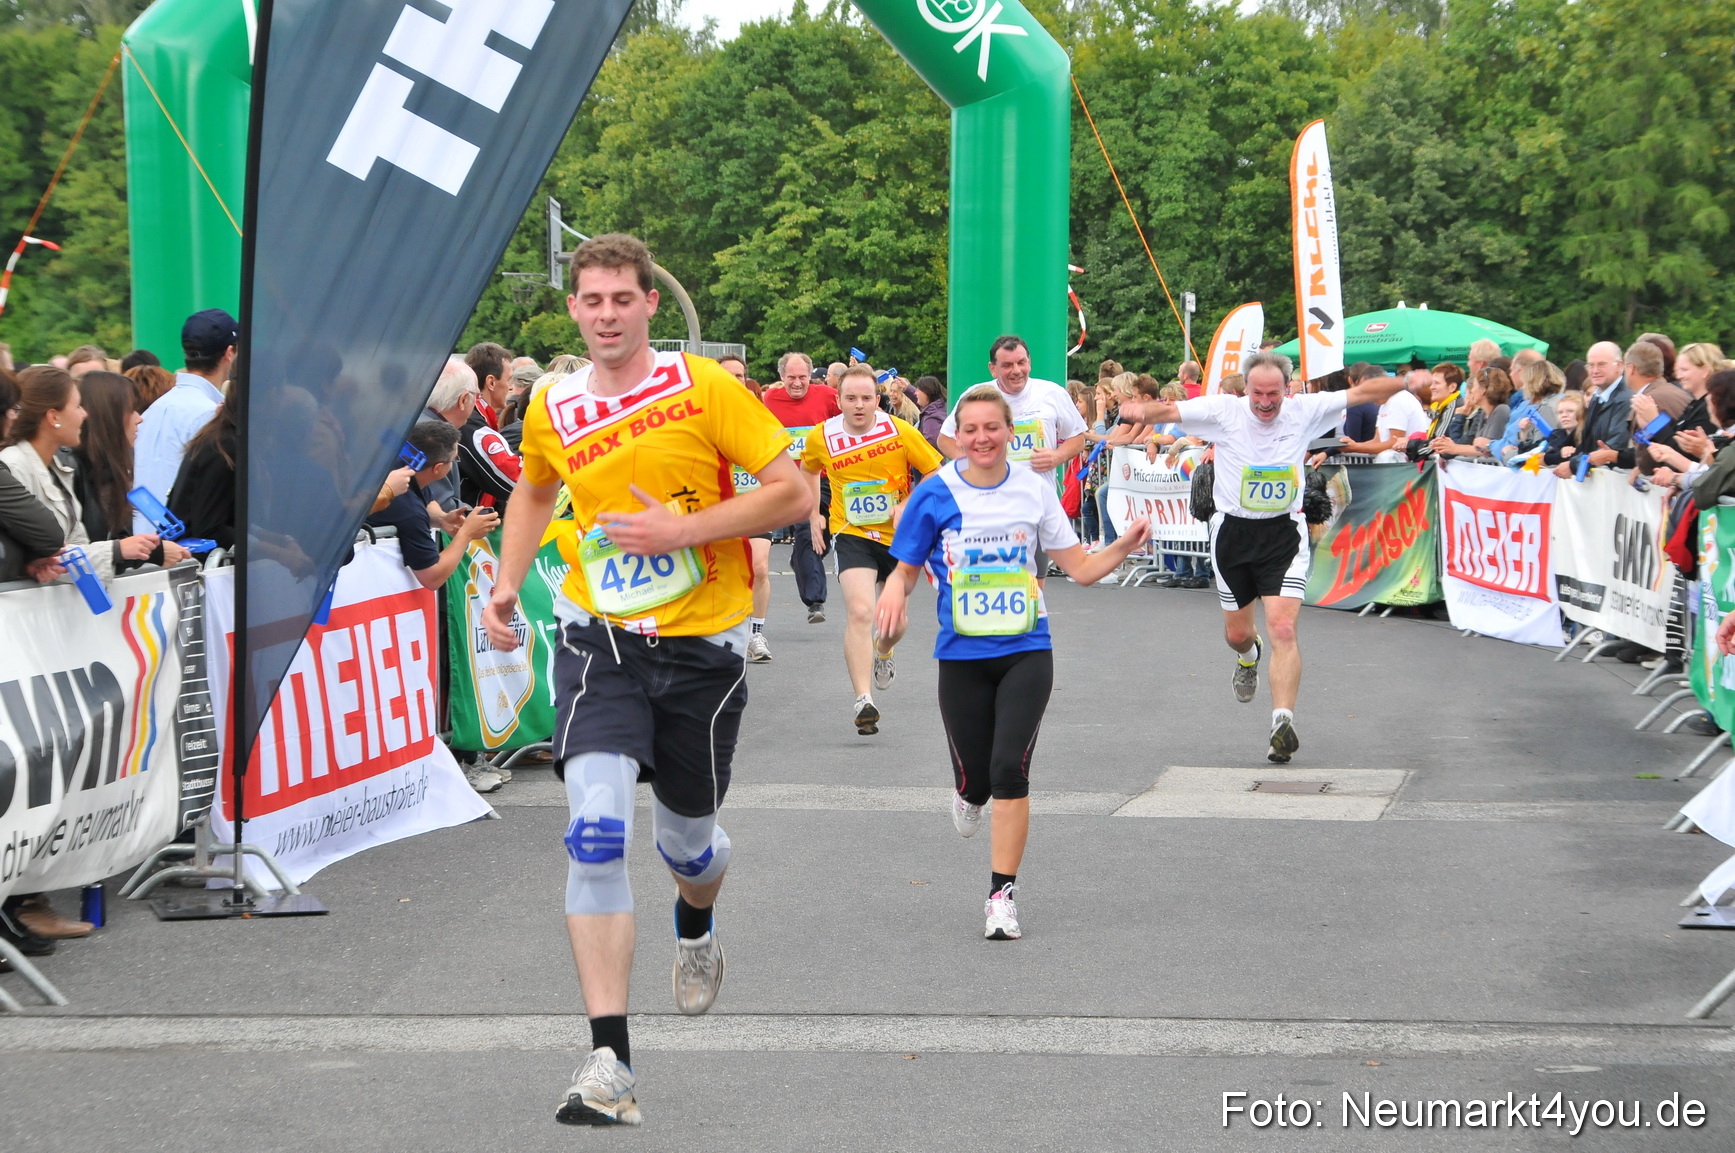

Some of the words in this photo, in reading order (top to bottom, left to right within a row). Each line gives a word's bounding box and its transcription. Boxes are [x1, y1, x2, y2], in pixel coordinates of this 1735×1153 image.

[567, 431, 622, 475] MAX
[629, 399, 703, 439] BÖGL
[832, 453, 864, 472] MAX
[867, 440, 904, 459] BÖGL
[1133, 468, 1180, 483] Frischmann
[1248, 481, 1287, 500] 703
[850, 494, 888, 514] 463
[964, 534, 1010, 544] expert
[1450, 500, 1541, 594] MEIER
[600, 551, 675, 593] 426
[620, 585, 655, 602] Michael
[957, 591, 1026, 616] 1346
[252, 608, 436, 797] MEIER
